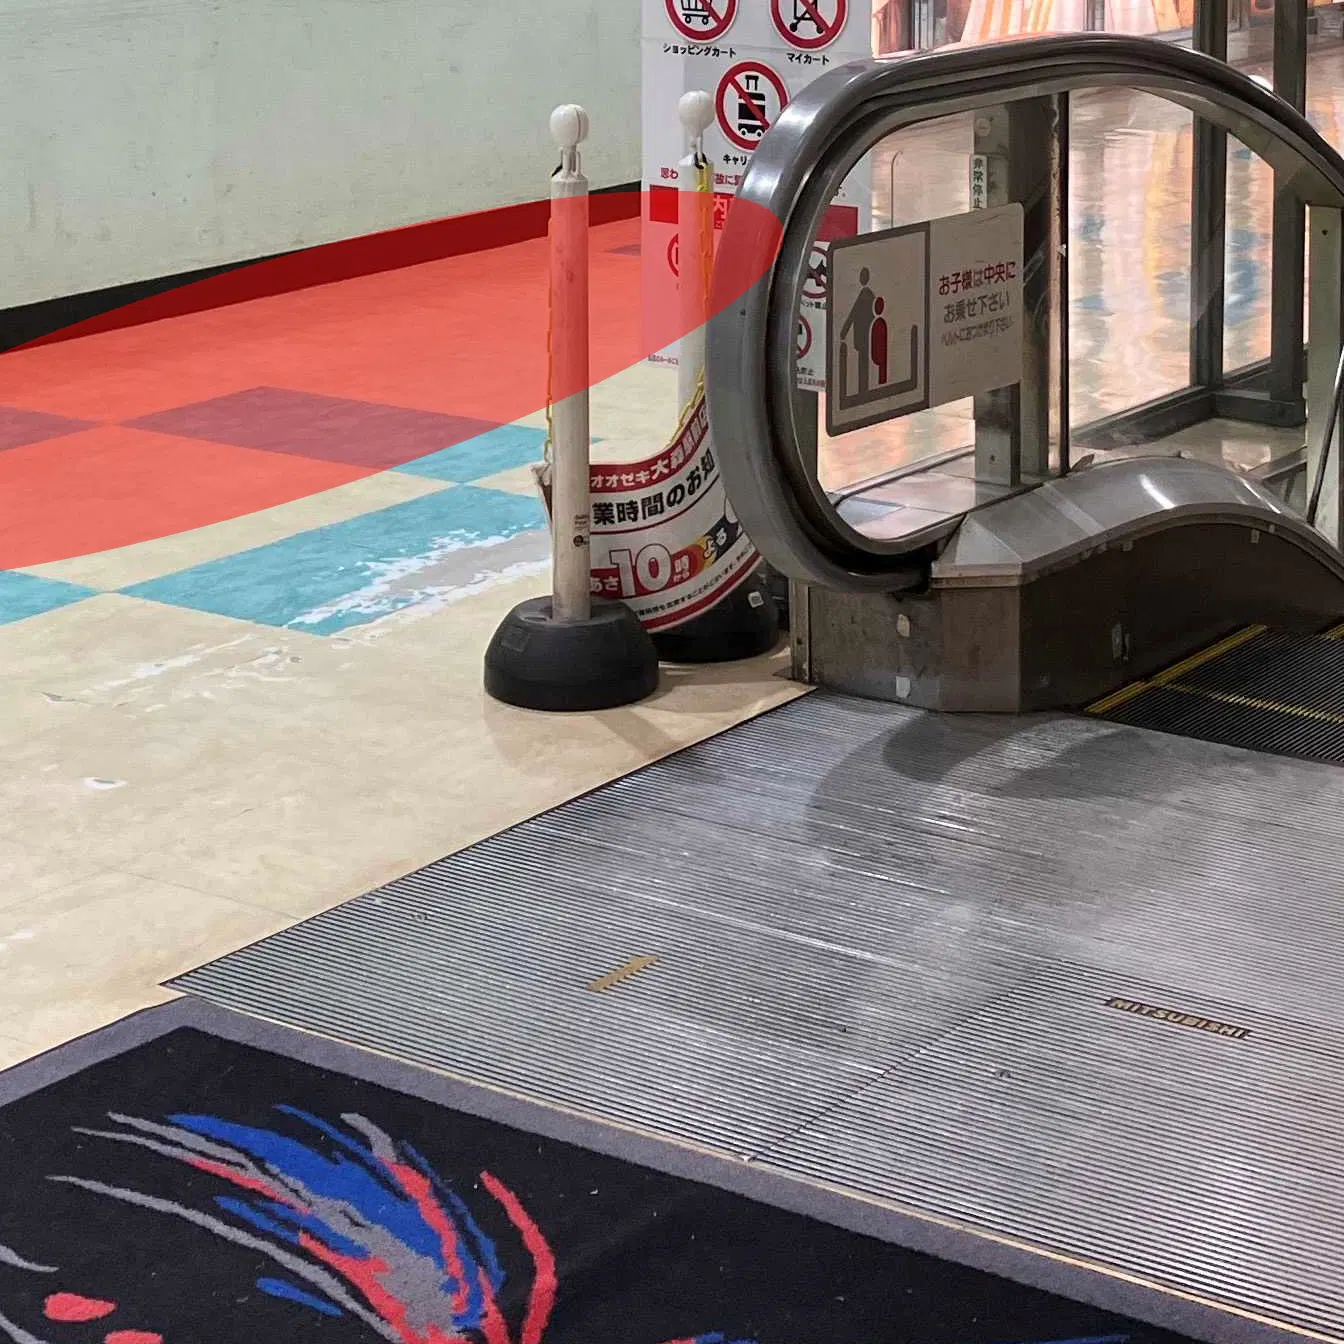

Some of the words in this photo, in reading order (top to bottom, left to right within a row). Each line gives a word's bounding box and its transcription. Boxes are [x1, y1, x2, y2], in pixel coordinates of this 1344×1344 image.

[663, 43, 737, 58] ショッピングカート
[786, 53, 830, 66] マイカート
[939, 261, 1017, 296] お子様は中央に
[943, 291, 1010, 323] お乗せ下さい
[1112, 998, 1246, 1039] MITSUBISHI
